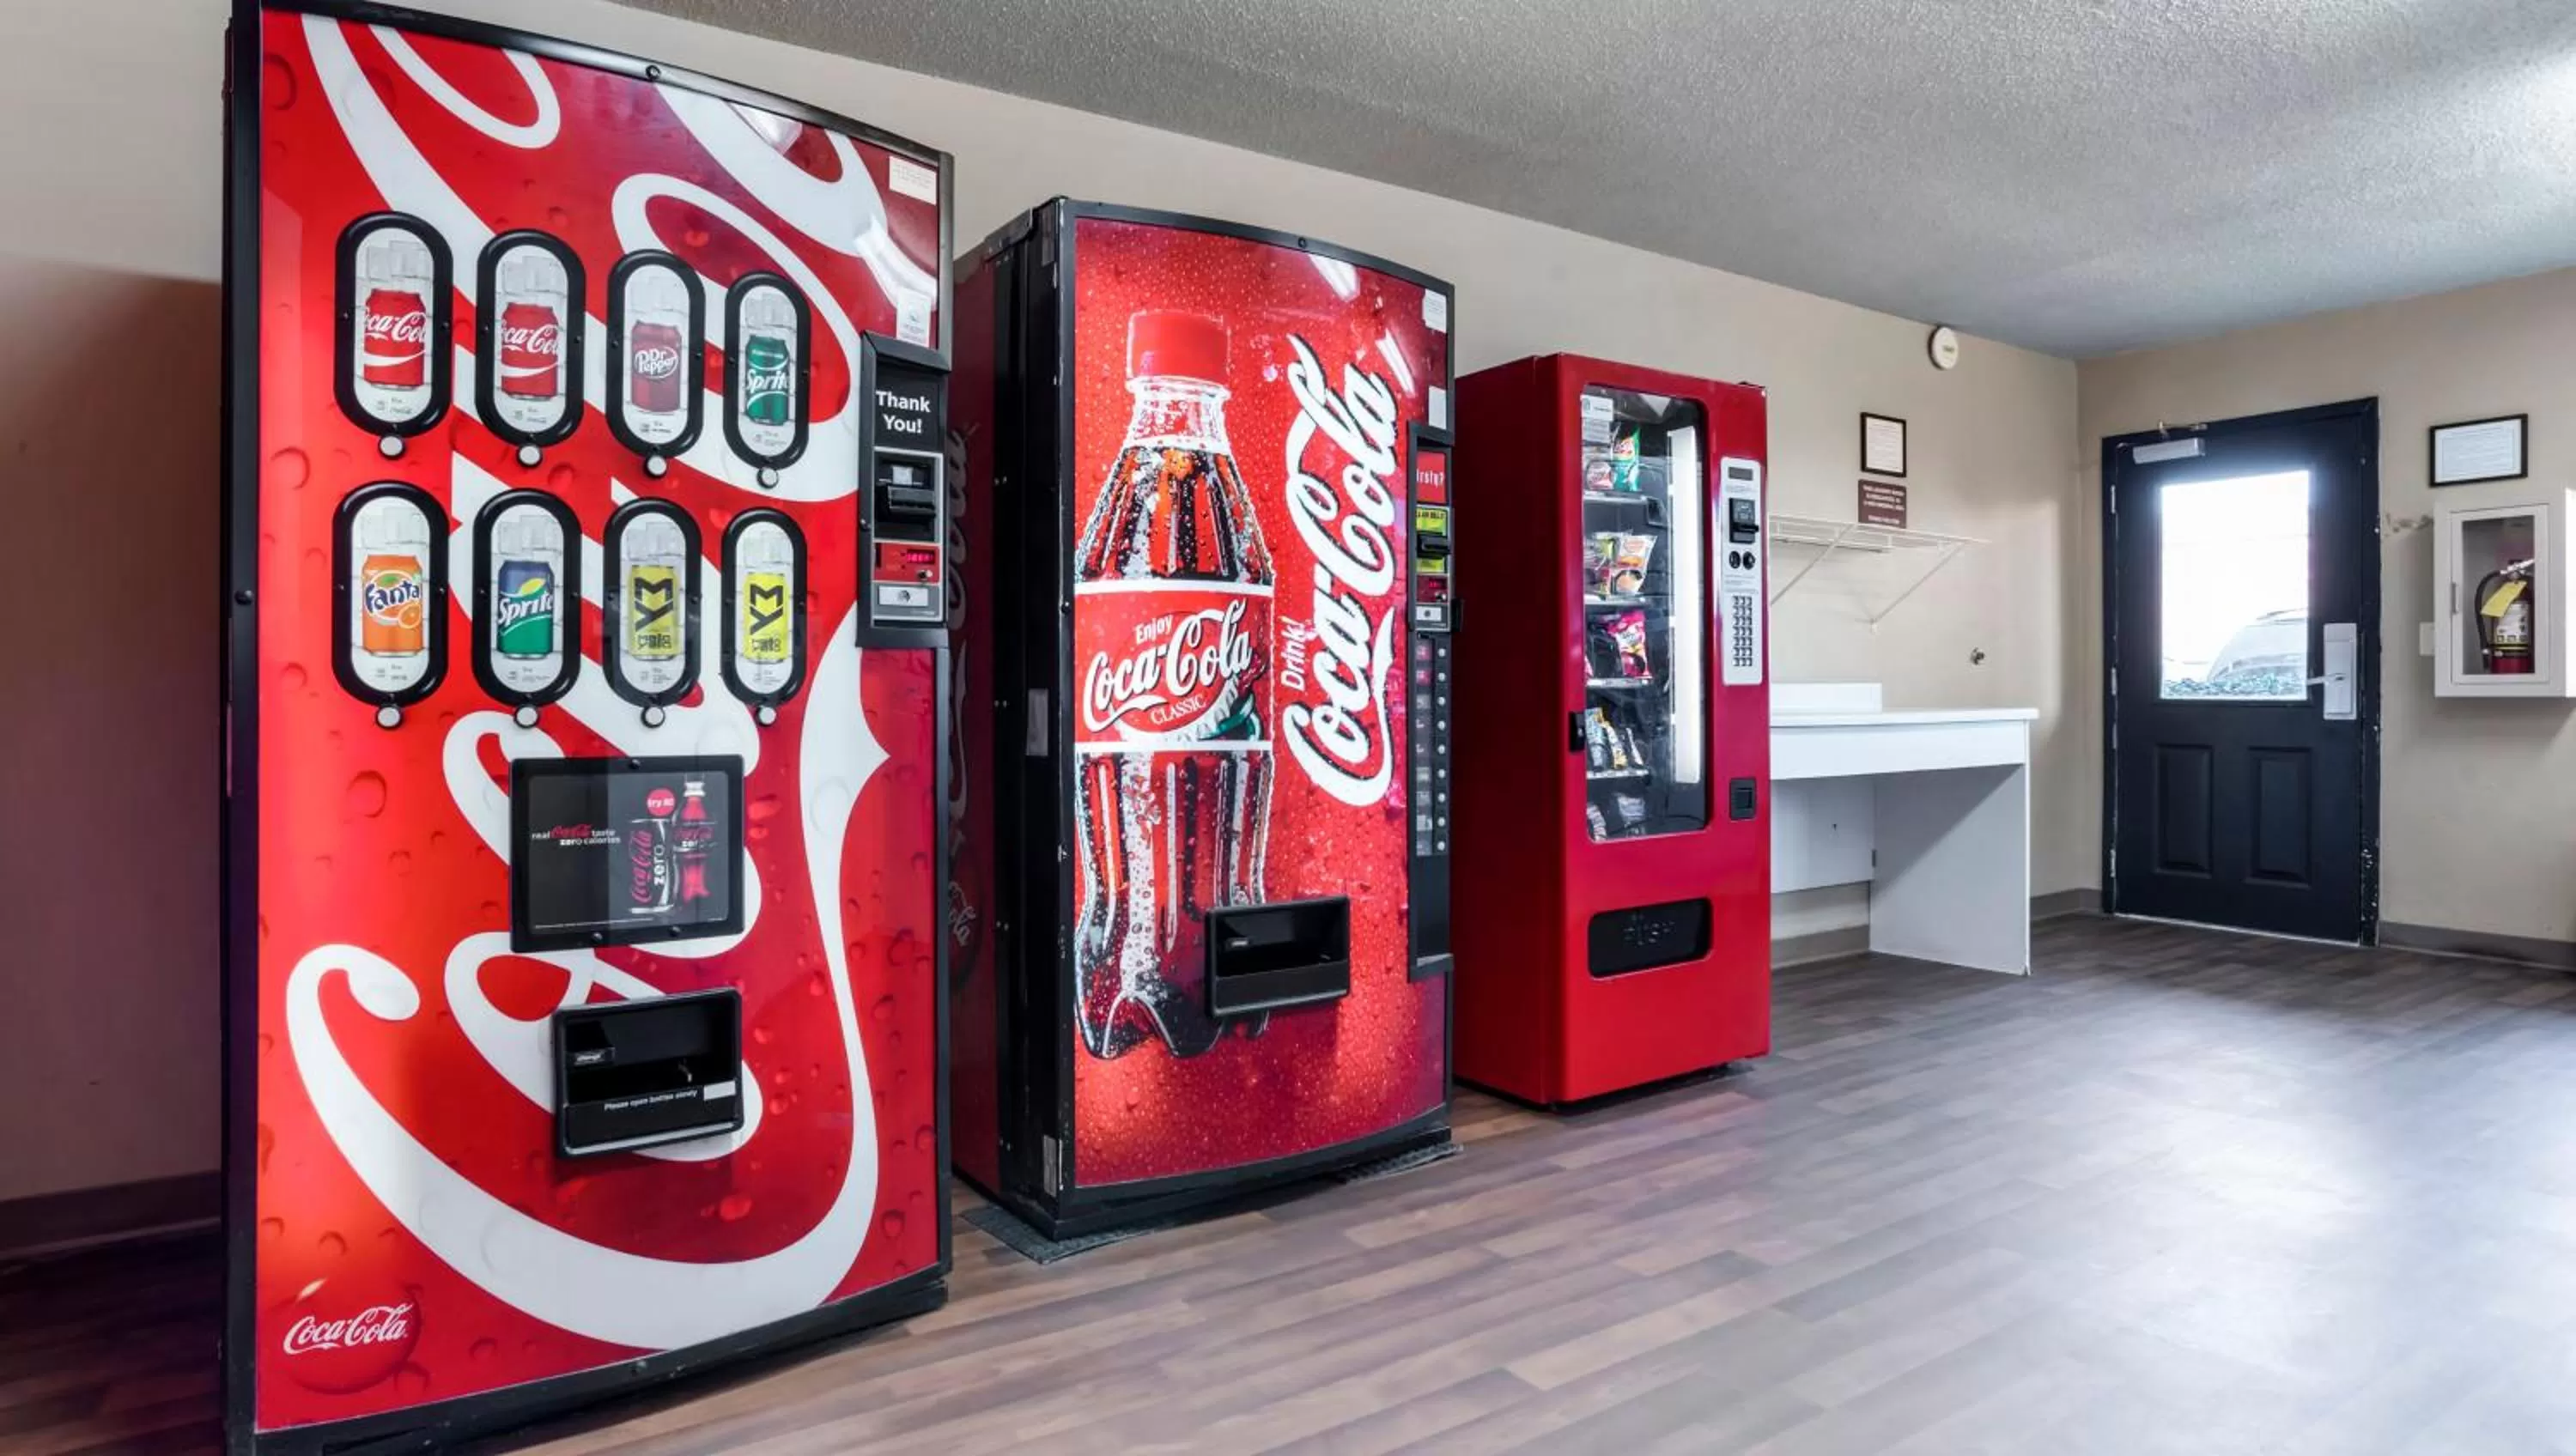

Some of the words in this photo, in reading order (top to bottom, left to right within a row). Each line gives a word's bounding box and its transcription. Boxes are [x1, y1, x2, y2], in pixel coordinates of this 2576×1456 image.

[649, 348, 667, 361] Dr
[876, 390, 931, 413] Thank
[883, 414, 923, 434] You!
[1282, 332, 1399, 807] Coca-Cola
[364, 579, 421, 614] Fanta
[1135, 615, 1173, 645] Enjoy
[1083, 598, 1254, 733] Coca-Cola
[1280, 615, 1306, 692] Drink!
[1150, 693, 1207, 725] CLASSIC
[532, 830, 550, 840] real
[560, 838, 582, 846] zero
[653, 844, 666, 886] zero
[283, 1303, 414, 1356] Coca-Cola
